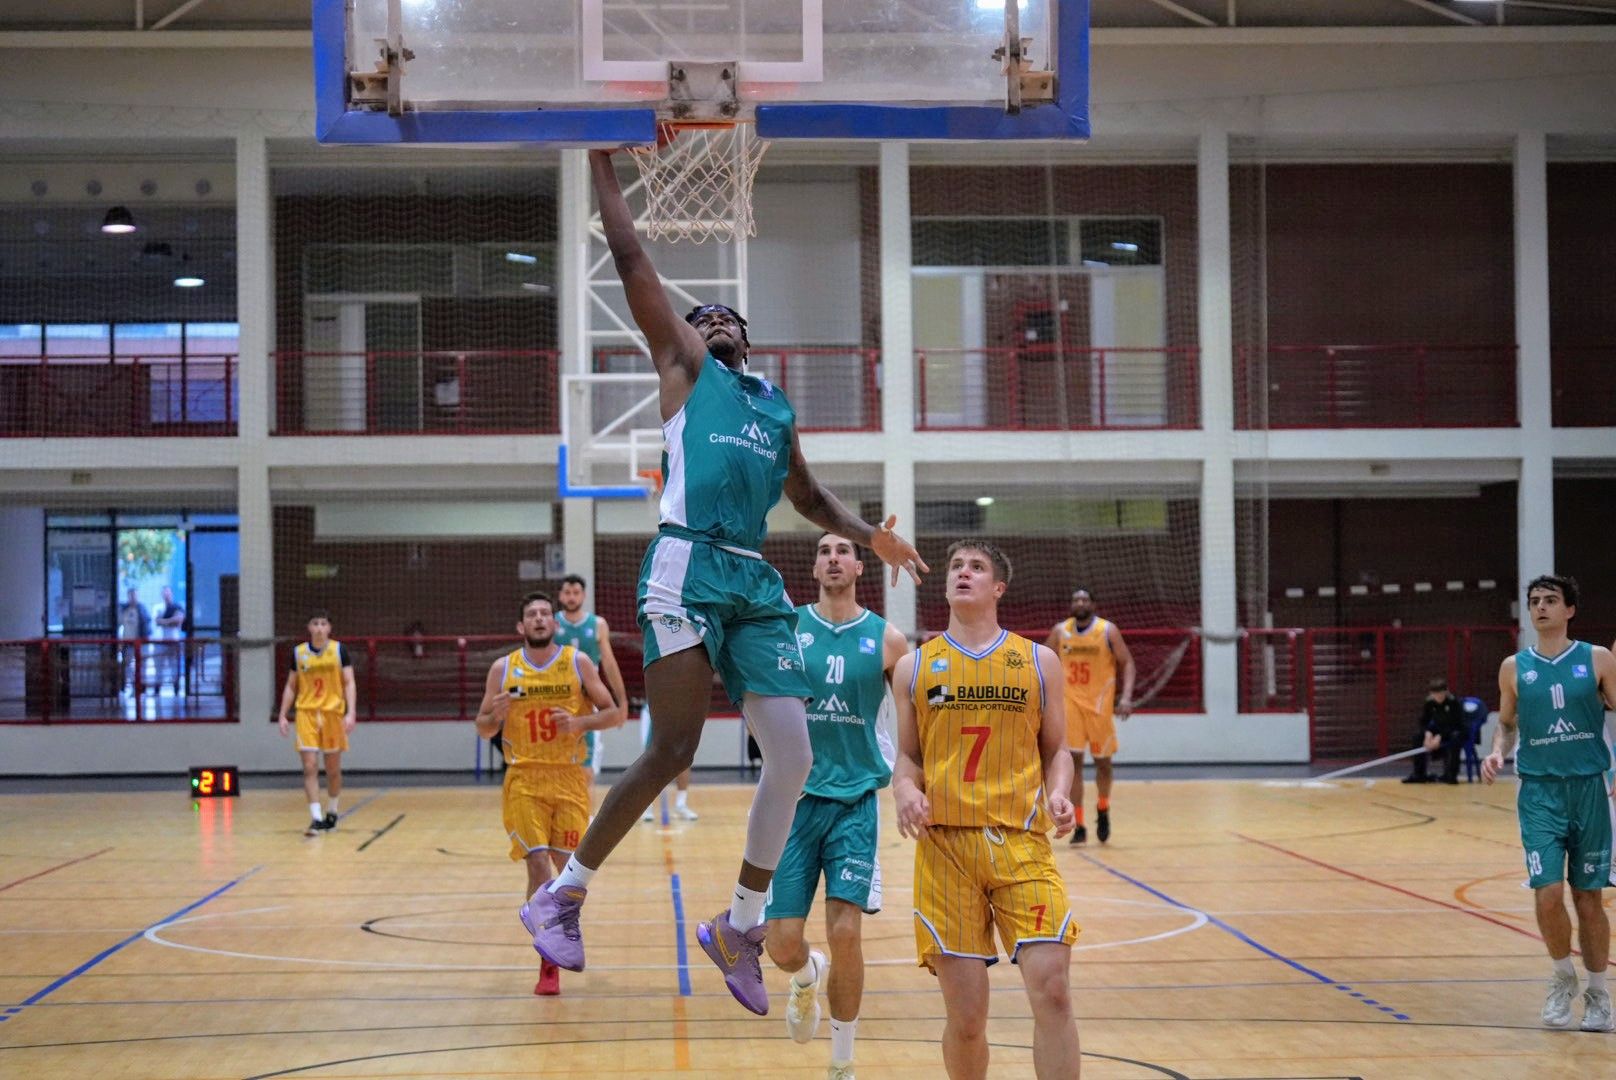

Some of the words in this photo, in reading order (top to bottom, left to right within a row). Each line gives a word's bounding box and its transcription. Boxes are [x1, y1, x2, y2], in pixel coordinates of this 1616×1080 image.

[709, 433, 752, 448] Camper
[825, 654, 845, 684] 20
[1067, 661, 1090, 685] 35
[314, 678, 323, 698] 2
[957, 686, 1028, 702] BAUBLOCK
[1550, 683, 1565, 710] 10
[524, 708, 557, 743] 19
[1530, 736, 1558, 747] Camper
[961, 726, 991, 782] 7
[199, 770, 230, 793] 21
[564, 830, 579, 848] 19
[1029, 904, 1047, 932] 7
